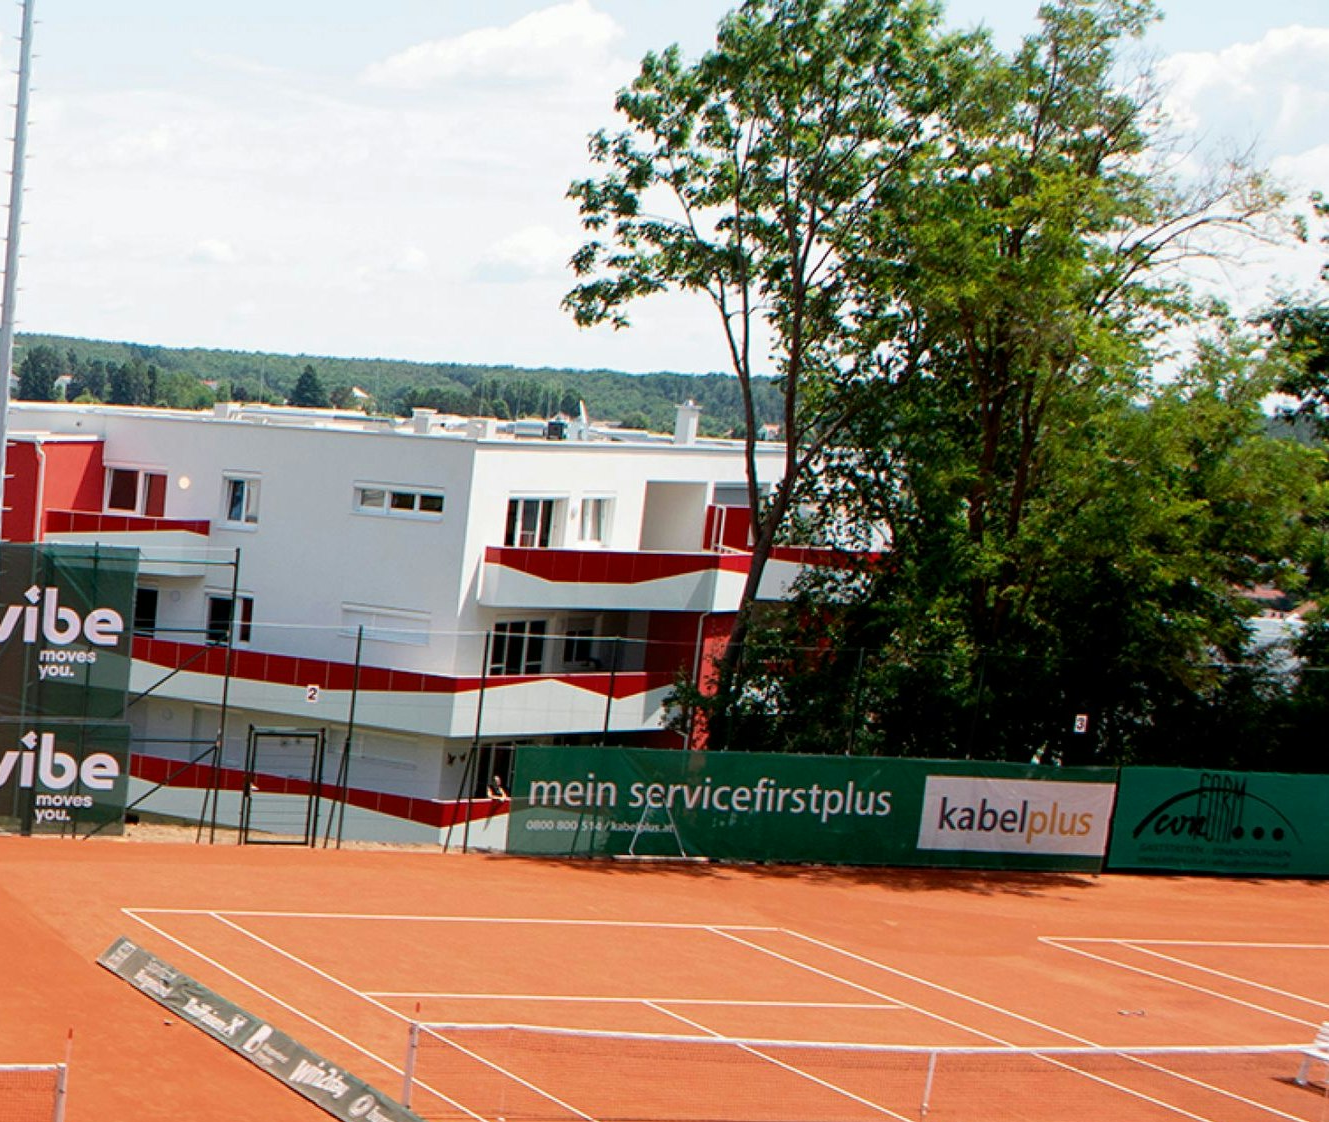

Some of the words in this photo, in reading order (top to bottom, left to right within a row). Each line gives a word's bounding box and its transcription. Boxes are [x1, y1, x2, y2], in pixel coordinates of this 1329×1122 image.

[39, 650, 96, 664] moves
[38, 664, 75, 680] you.
[35, 794, 93, 807] moves
[528, 773, 618, 808] mein
[628, 776, 893, 823] servicefirstplus
[34, 808, 71, 824] you.
[938, 796, 1093, 844] kabelplus
[525, 819, 555, 831] 0800
[556, 819, 579, 831] 800
